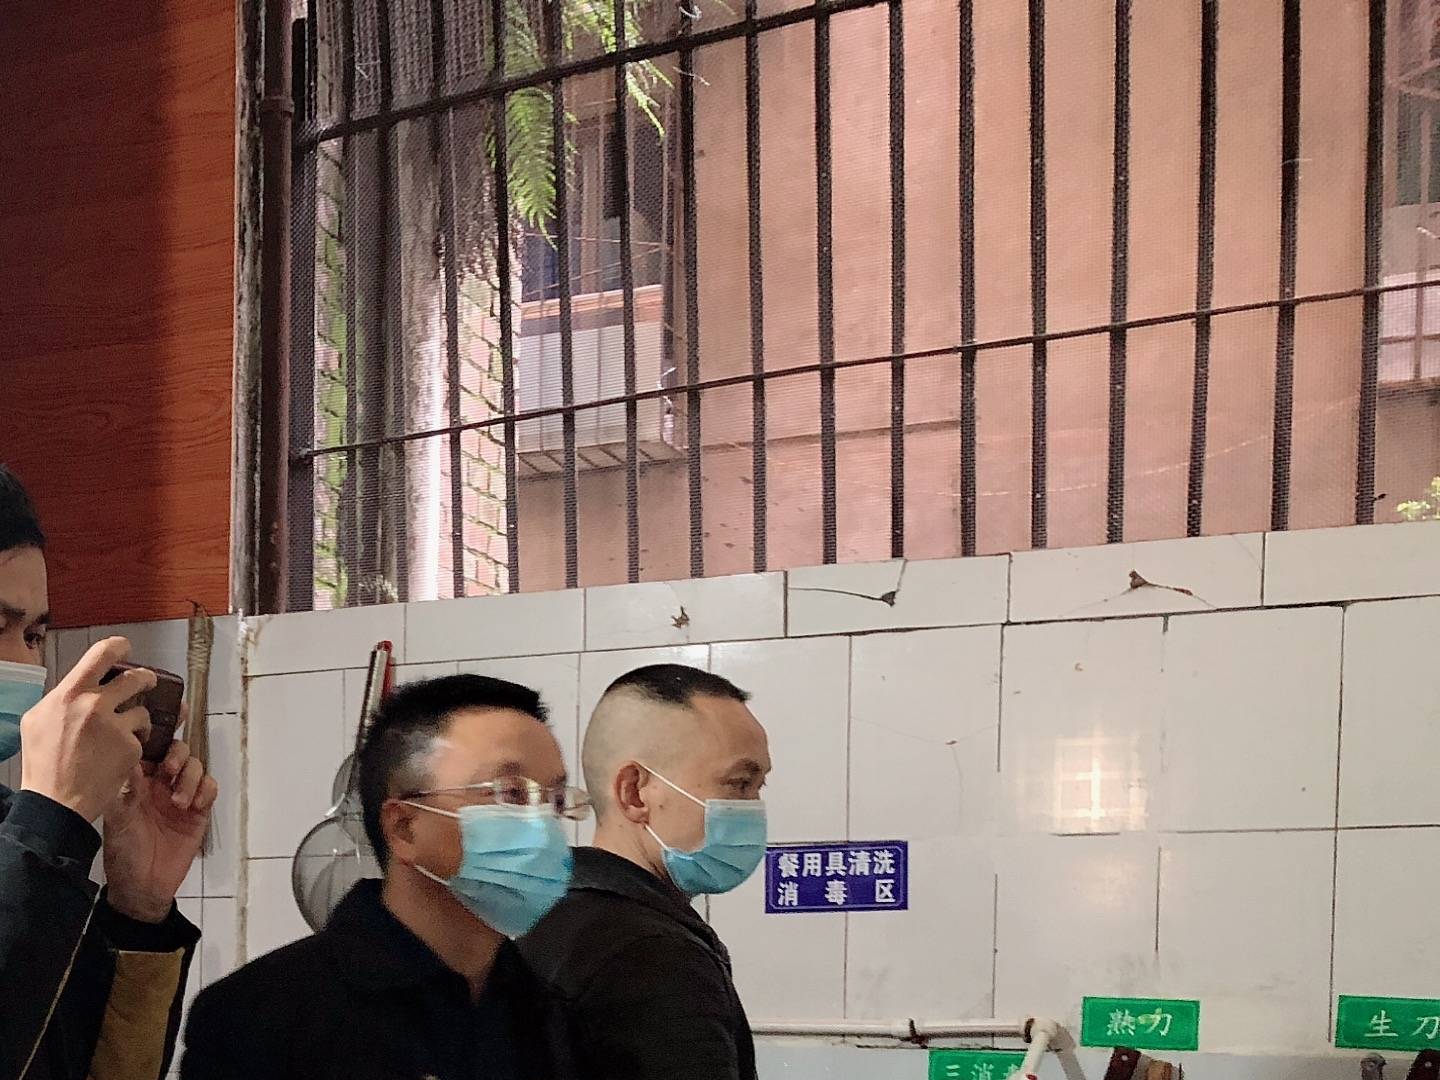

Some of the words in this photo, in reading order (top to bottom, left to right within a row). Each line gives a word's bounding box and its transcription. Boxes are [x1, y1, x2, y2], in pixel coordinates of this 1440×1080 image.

[778, 849, 896, 878] 餐用具清洗
[777, 879, 896, 906] 消毒区
[1364, 1009, 1440, 1040] 生刀
